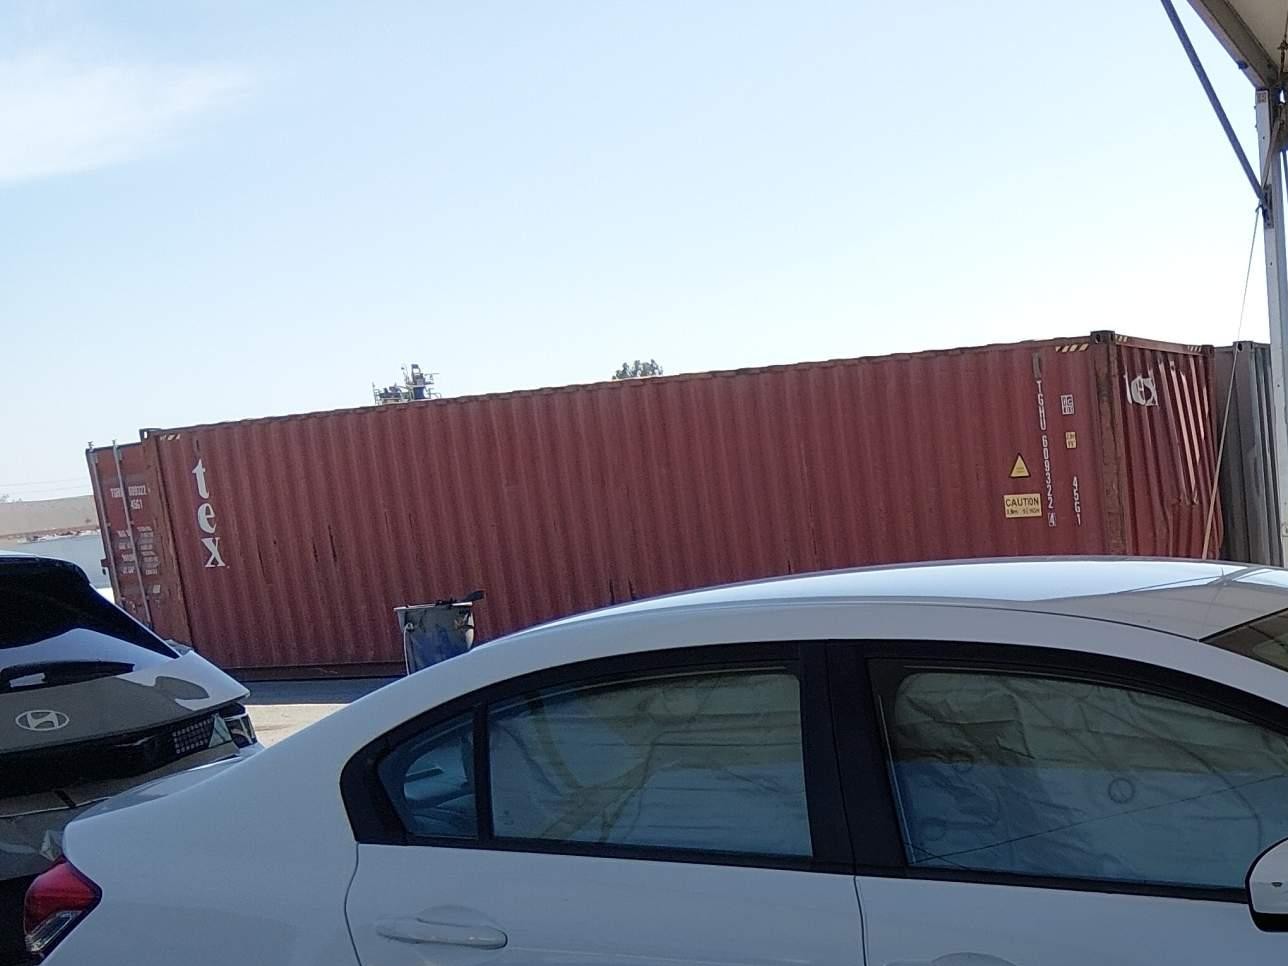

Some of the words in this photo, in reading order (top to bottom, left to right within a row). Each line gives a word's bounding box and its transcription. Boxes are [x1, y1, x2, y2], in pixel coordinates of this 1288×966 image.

[1036, 380, 1047, 430] TGHU
[1042, 435, 1053, 509] 609322
[192, 459, 226, 568] tex
[1005, 497, 1039, 507] CAUTION
